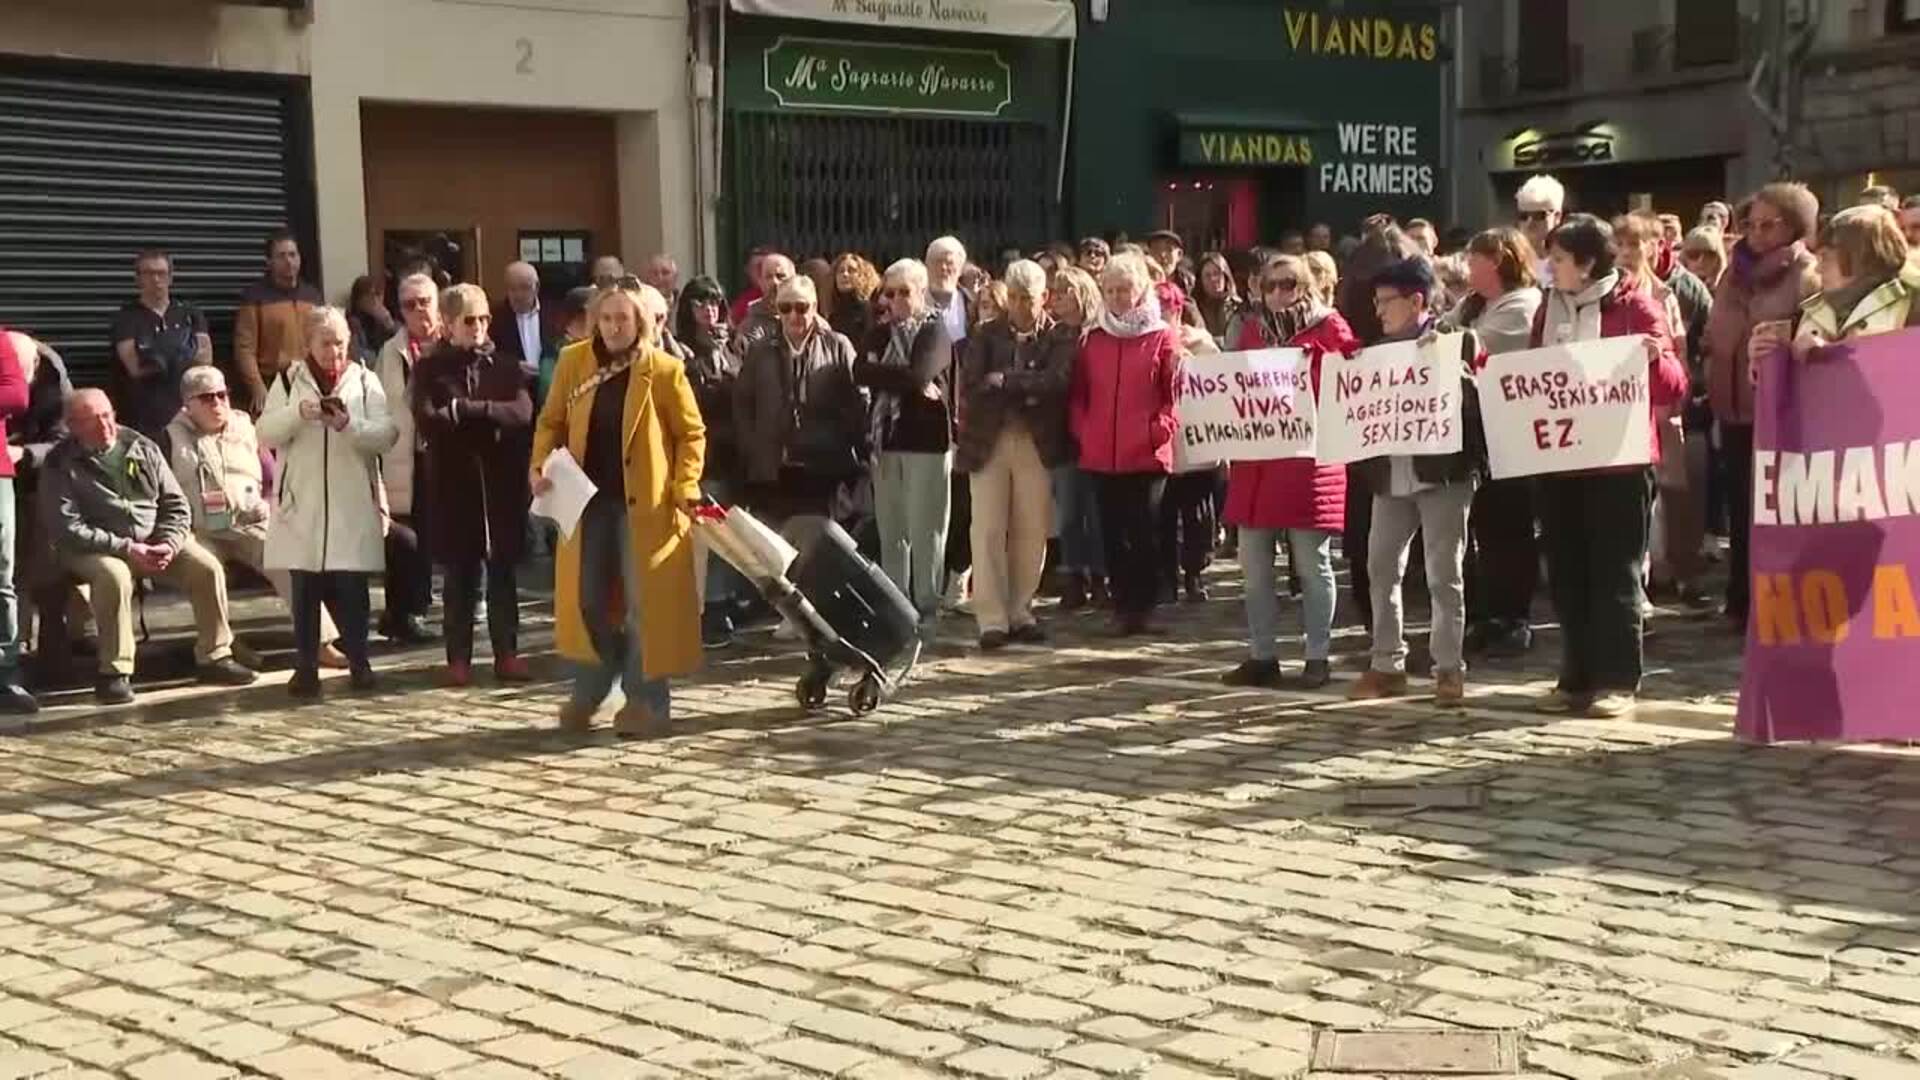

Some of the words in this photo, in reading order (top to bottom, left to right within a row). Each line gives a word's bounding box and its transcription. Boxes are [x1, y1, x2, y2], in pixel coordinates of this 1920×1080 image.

[1285, 10, 1436, 61] VIANDAS
[515, 37, 534, 75] 2
[831, 58, 914, 92] Sagrario
[918, 64, 995, 95] Navarro
[1200, 133, 1313, 165] VIANDAS
[1320, 163, 1433, 194] FARMERS
[1370, 371, 1381, 391] A
[1390, 367, 1430, 387] LAS
[1500, 372, 1569, 401] ERASO
[1345, 393, 1450, 425] AGRESIONES
[1185, 425, 1204, 446] EL
[1278, 417, 1312, 440] MATA
[1362, 416, 1450, 448] SEXISTAS
[1756, 569, 1848, 646] NO
